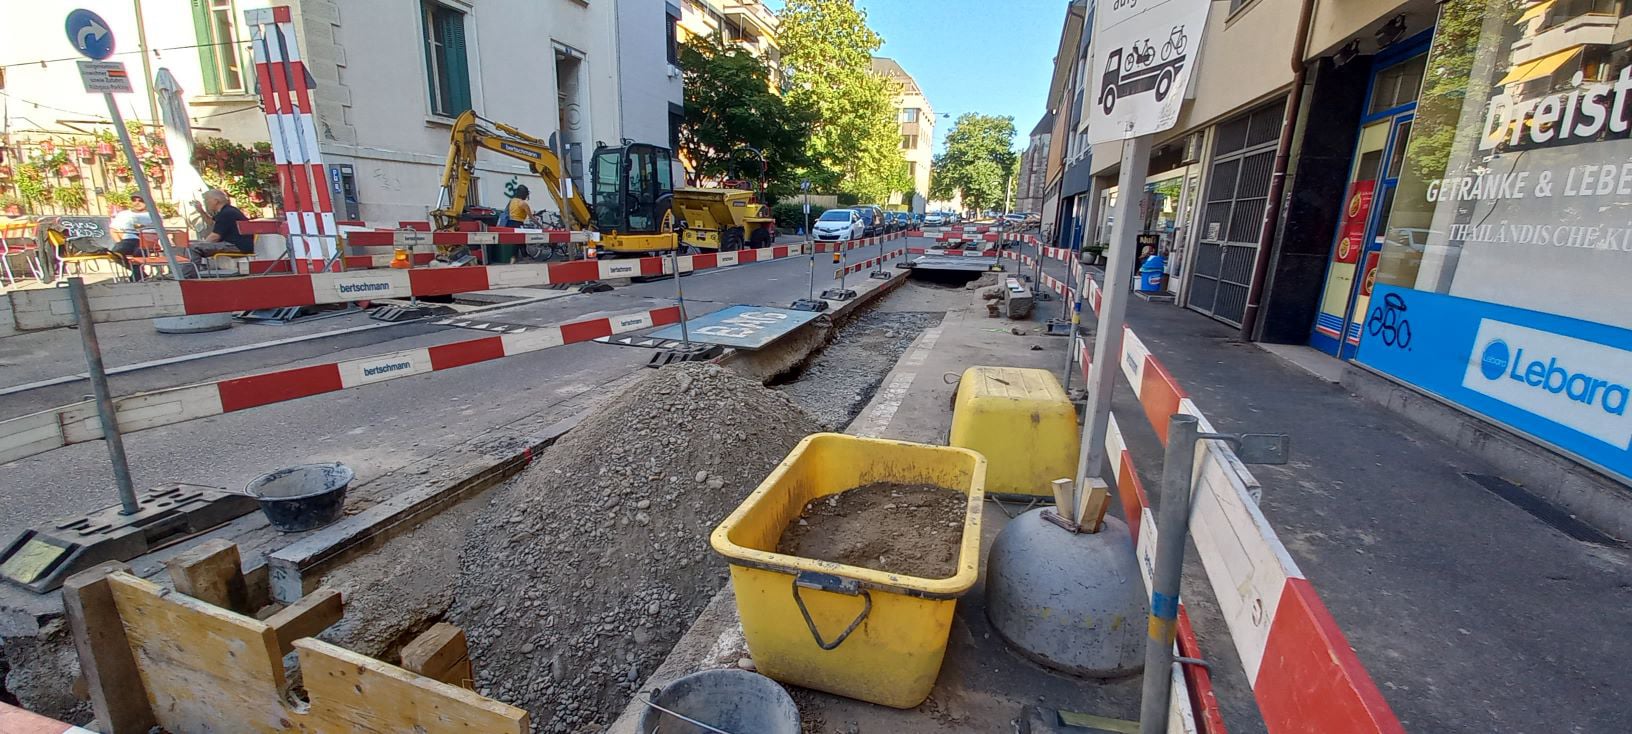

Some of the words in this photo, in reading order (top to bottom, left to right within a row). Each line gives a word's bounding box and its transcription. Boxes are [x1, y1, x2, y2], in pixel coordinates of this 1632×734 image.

[1478, 64, 1632, 151] Dreist
[1426, 171, 1530, 202] GETRÄNKE
[1534, 170, 1553, 198] &
[1448, 219, 1600, 249] THAILÄNDISCHE
[339, 282, 390, 293] bertschmann
[363, 361, 411, 377] bertschmann
[1510, 348, 1631, 416] Lebara
